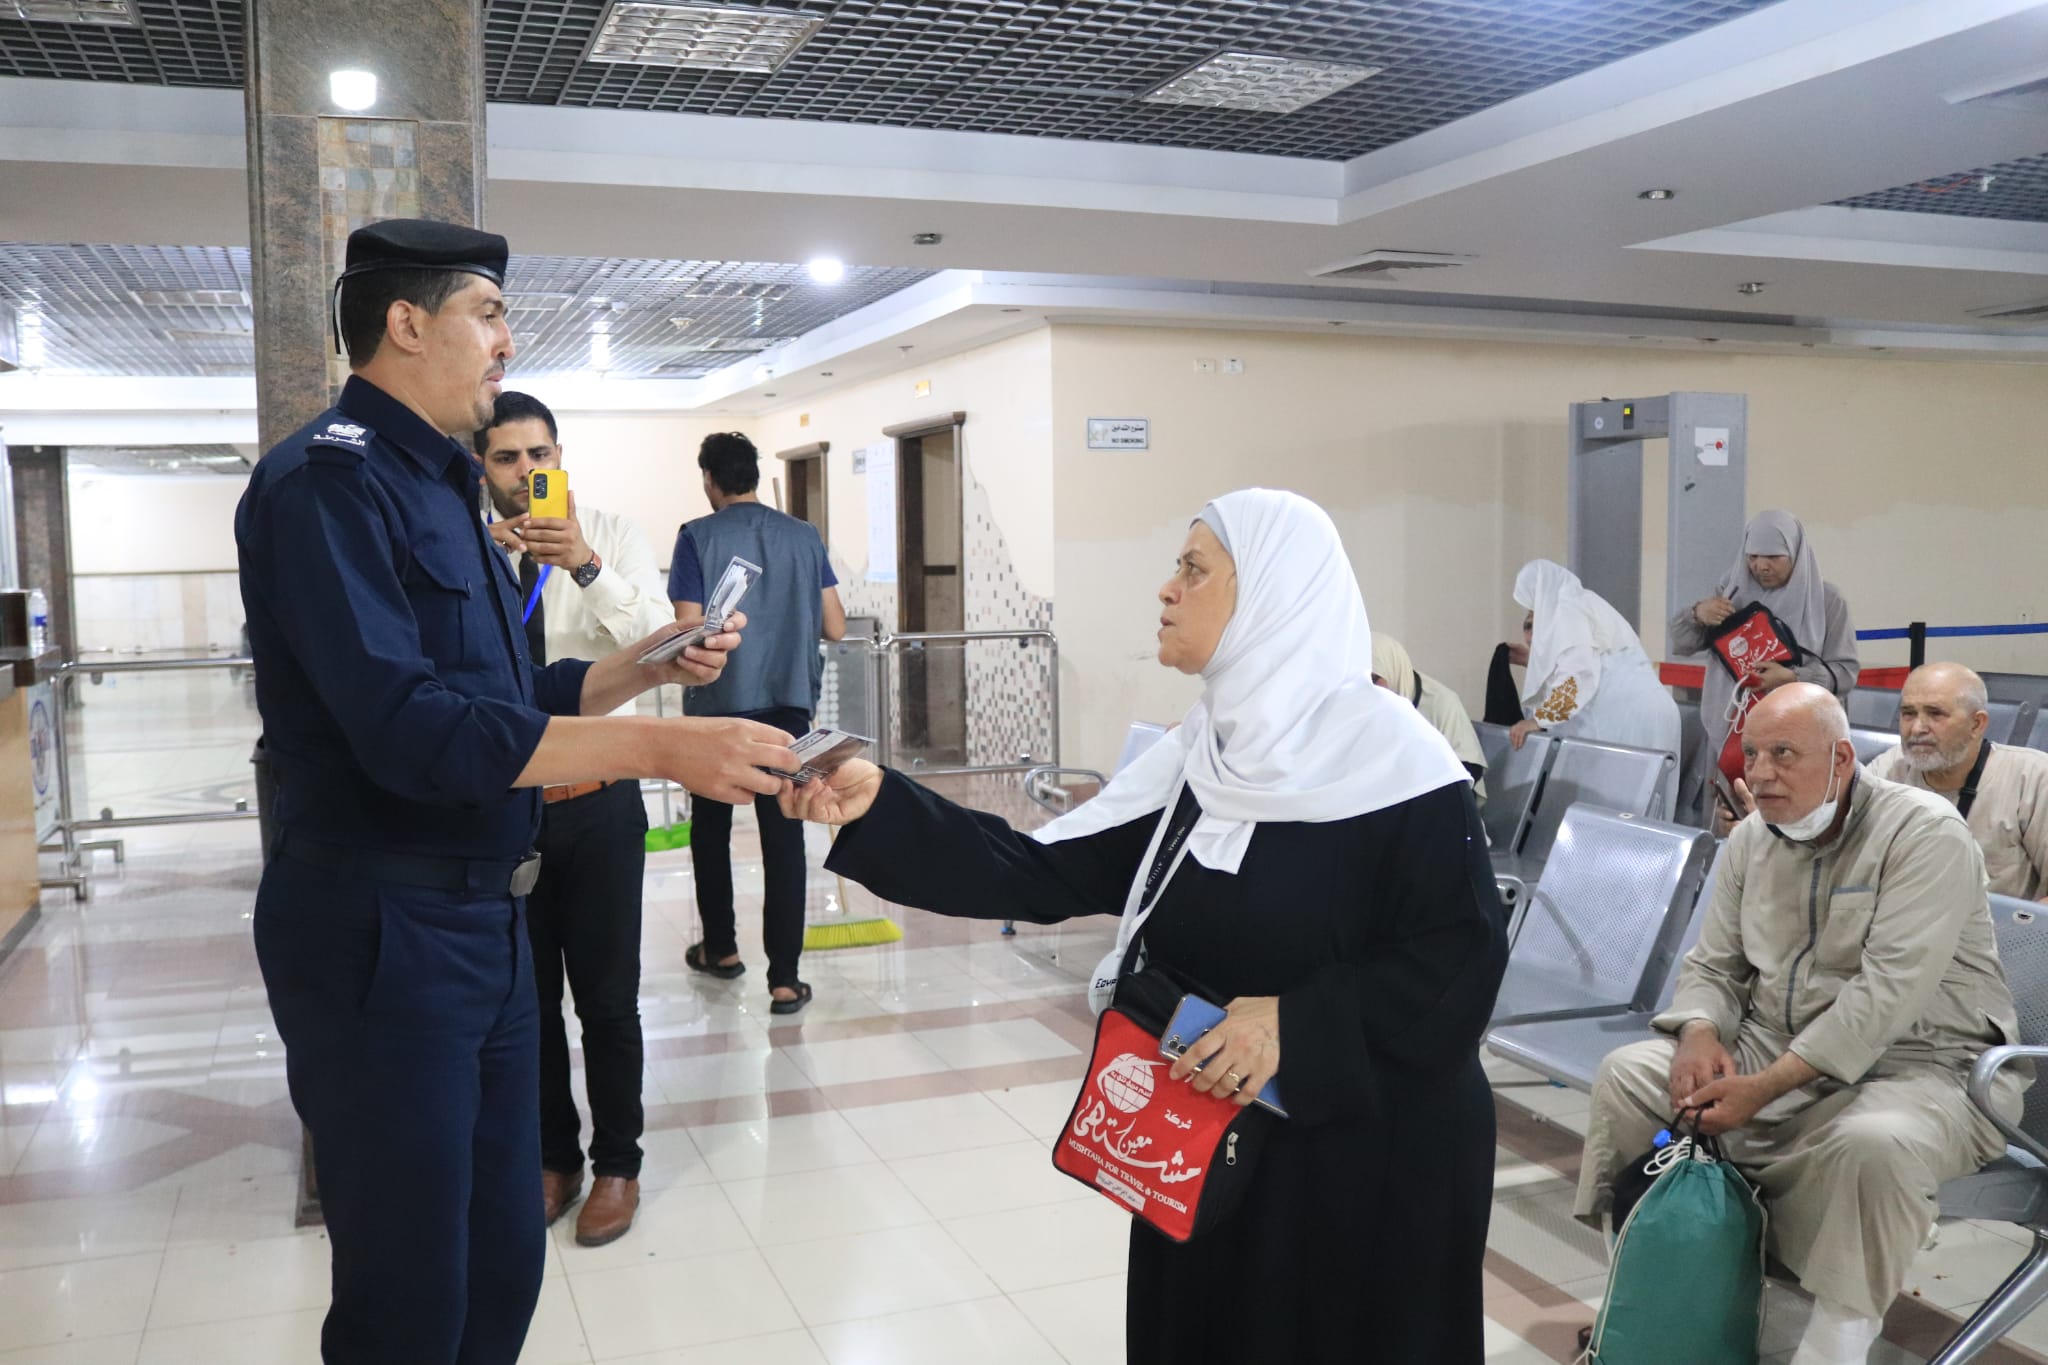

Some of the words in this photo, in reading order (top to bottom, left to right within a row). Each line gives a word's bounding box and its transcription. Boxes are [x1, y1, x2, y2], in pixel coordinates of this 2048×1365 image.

[313, 434, 365, 446] الشرطة
[1164, 1108, 1193, 1130] شركة
[1115, 1117, 1153, 1158] معين
[1068, 1138, 1104, 1166] MUSHTAHA
[1104, 1161, 1119, 1175] FOR
[1120, 1170, 1144, 1192] TRAVEL
[1145, 1187, 1151, 1196] &
[1152, 1190, 1188, 1214] TOURISM
